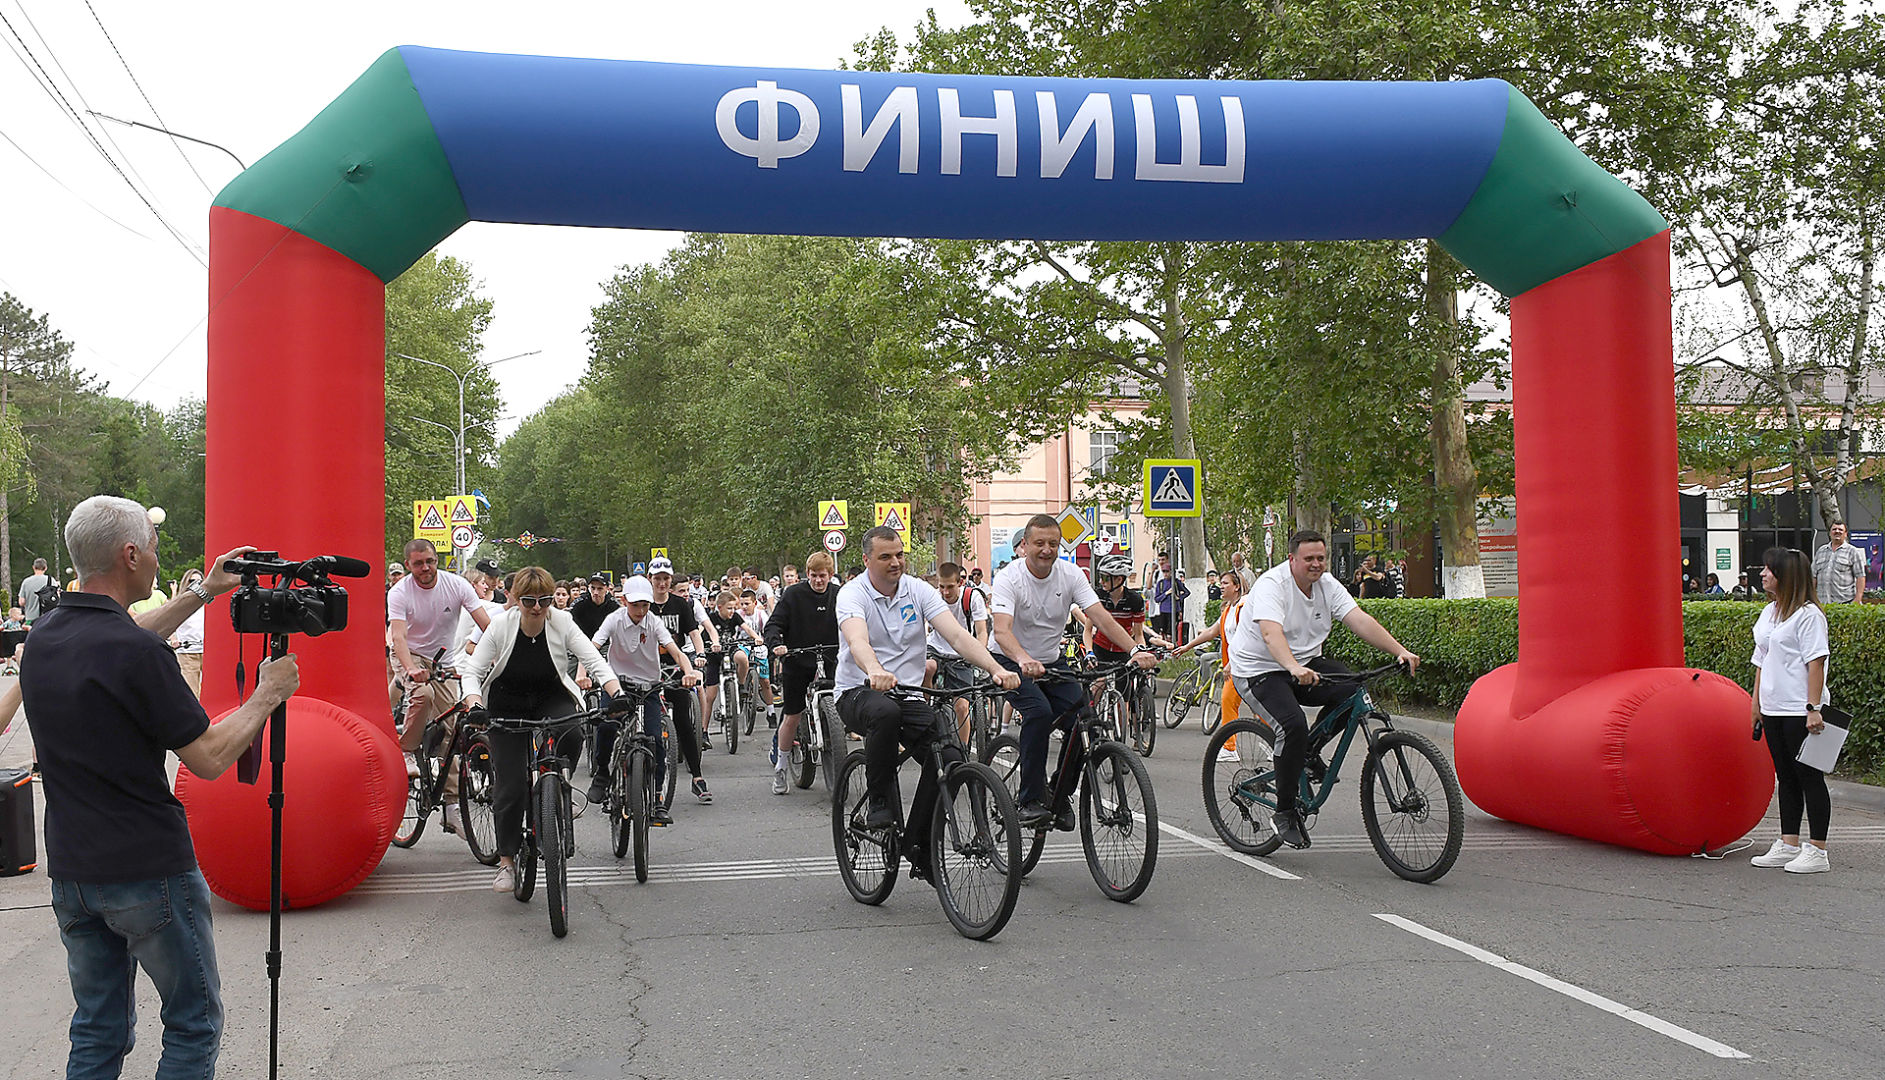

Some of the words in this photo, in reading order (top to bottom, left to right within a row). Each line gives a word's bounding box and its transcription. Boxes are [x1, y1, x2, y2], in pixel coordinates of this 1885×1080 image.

[715, 80, 1247, 183] ФИНИШ
[456, 533, 469, 541] 40
[828, 536, 841, 545] 40
